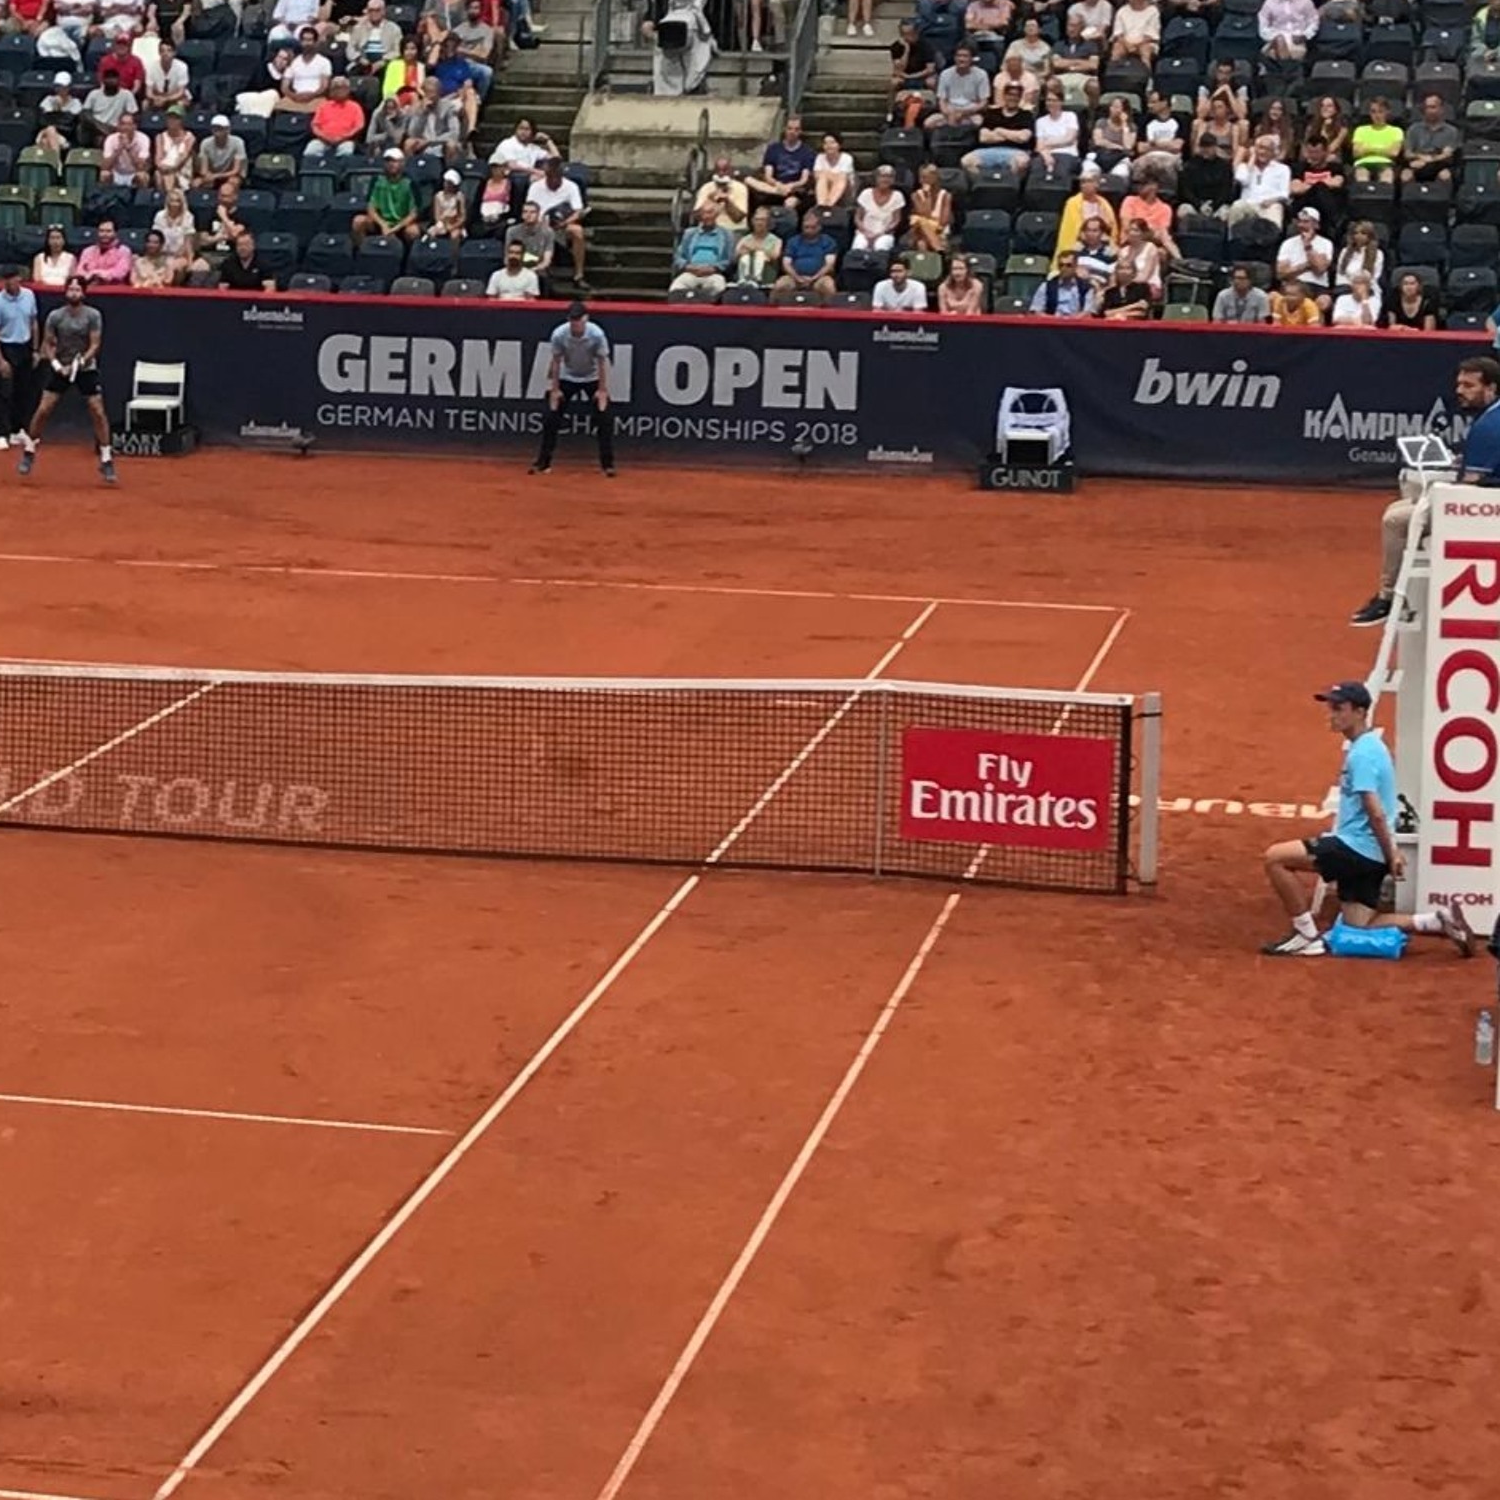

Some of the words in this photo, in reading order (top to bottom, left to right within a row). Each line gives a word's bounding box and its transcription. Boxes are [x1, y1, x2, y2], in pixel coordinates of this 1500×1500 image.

[654, 344, 860, 411] OPEN
[1133, 357, 1281, 409] bwin
[112, 432, 163, 446] MARY
[316, 403, 435, 429] GERMAN
[445, 407, 544, 435] TENNIS
[558, 411, 786, 441] HMPIONSHIPS
[794, 422, 859, 446] 2018
[1348, 447, 1398, 463] Genau
[990, 467, 1061, 489] GUINOT
[1430, 540, 1500, 867] RICOH
[977, 752, 1034, 789] Fly
[116, 774, 330, 832] TOUR
[910, 779, 1099, 831] Emirates
[1428, 892, 1494, 907] RICOH
